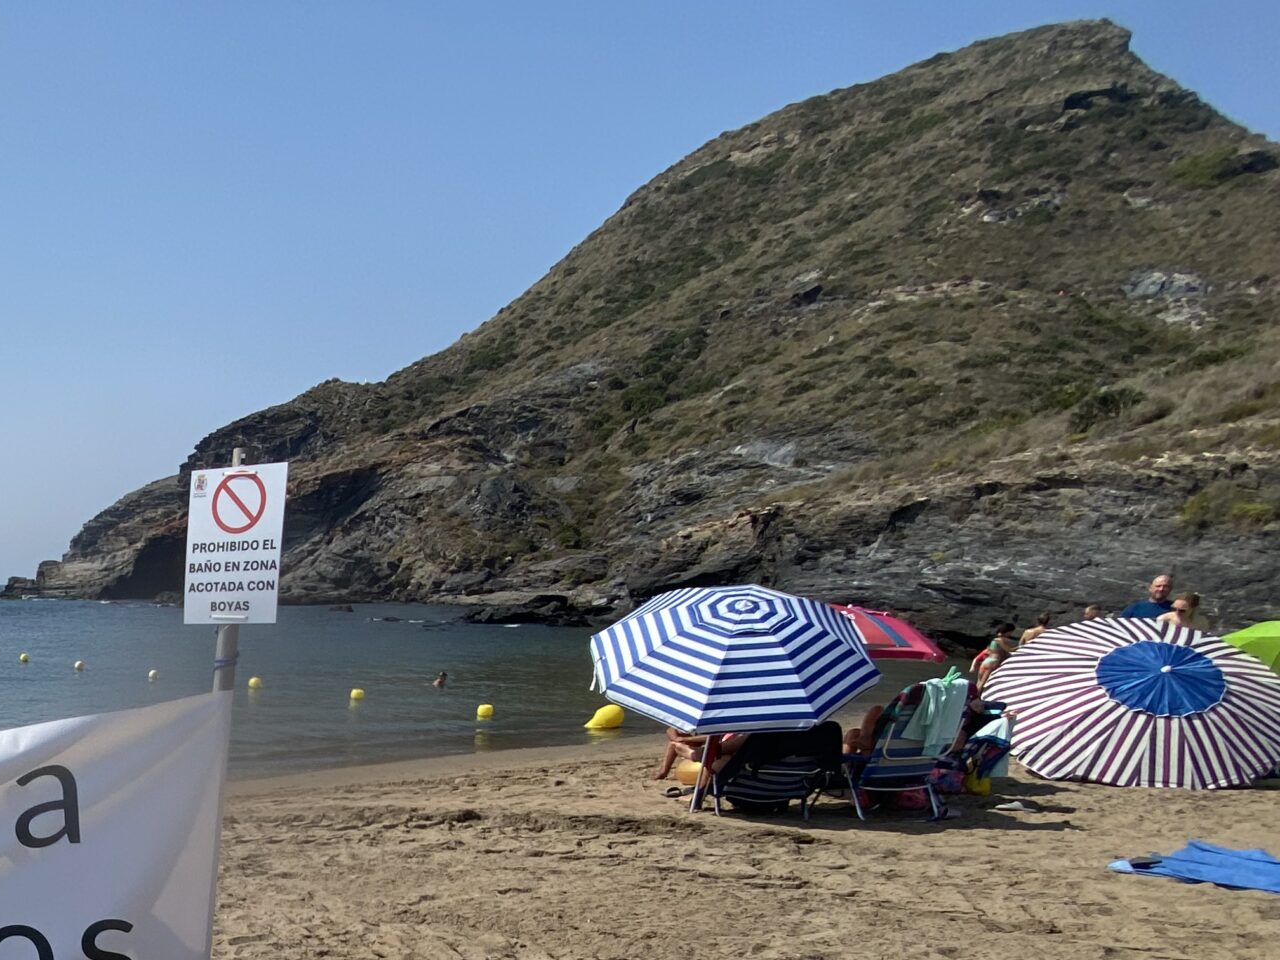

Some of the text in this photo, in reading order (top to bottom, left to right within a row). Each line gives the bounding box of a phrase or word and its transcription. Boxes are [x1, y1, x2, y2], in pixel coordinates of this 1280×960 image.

[192, 539, 277, 553] PROHIBIDO EL
[189, 560, 277, 573] BAÑO EN ZONA
[188, 580, 275, 593] ACOTADA CON
[210, 601, 250, 612] BOYAS
